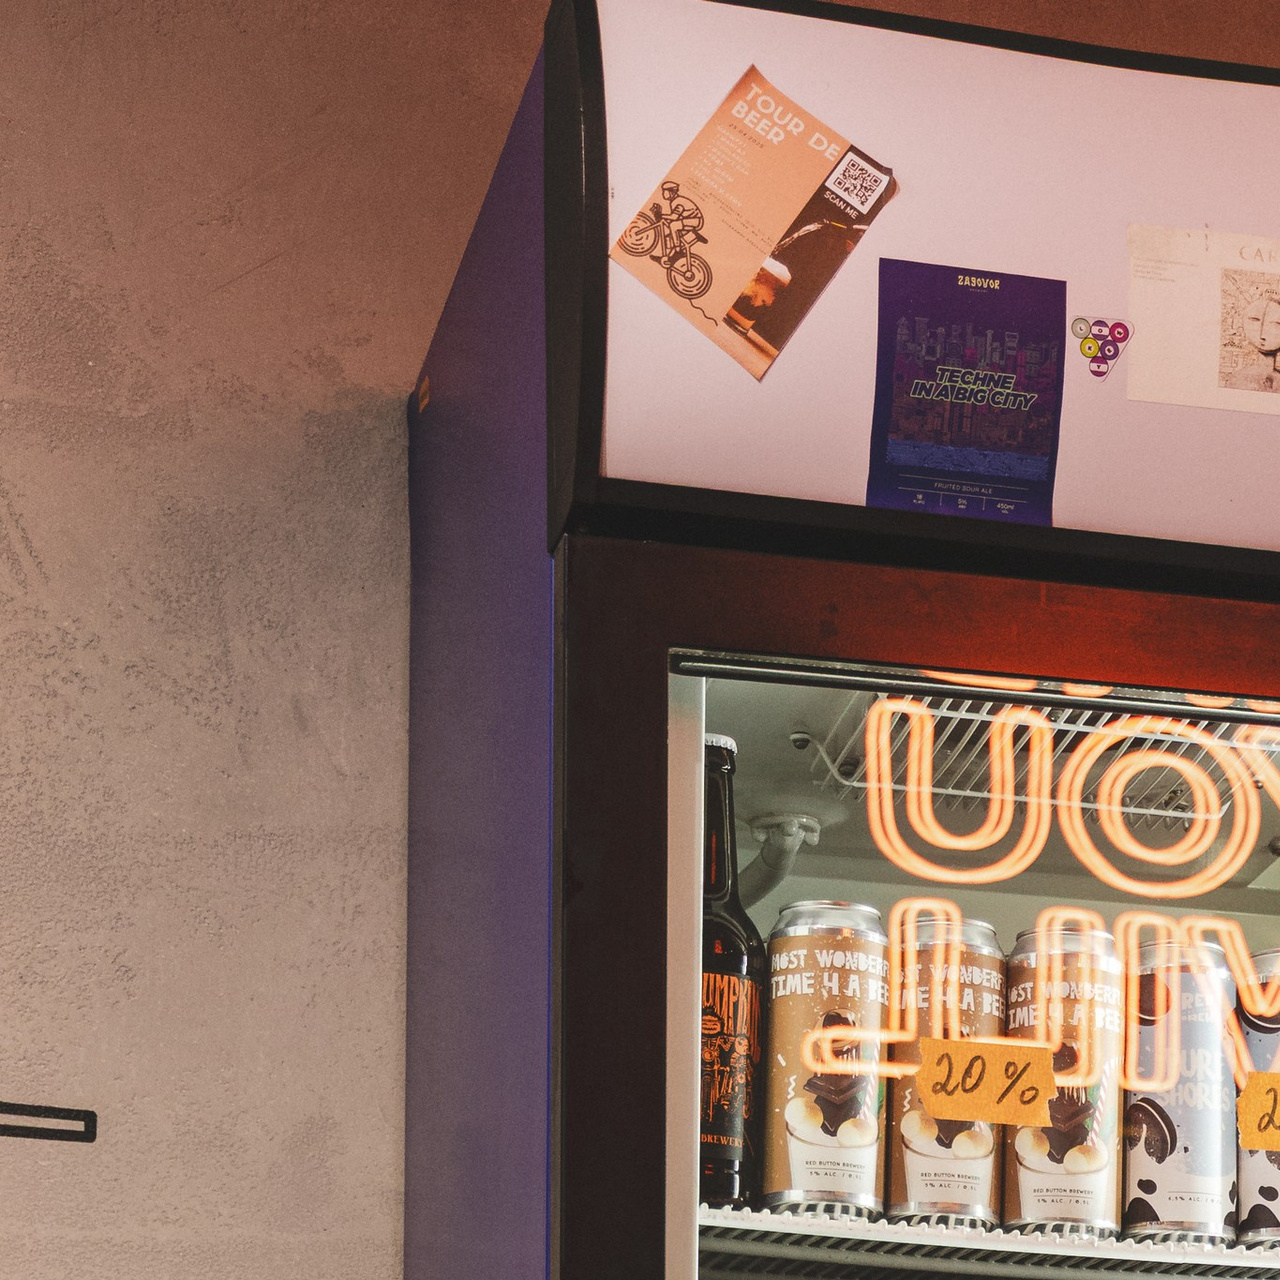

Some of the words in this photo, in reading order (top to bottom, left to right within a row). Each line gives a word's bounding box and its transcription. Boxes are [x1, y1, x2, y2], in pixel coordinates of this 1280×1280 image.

[731, 100, 785, 145] BEER
[745, 83, 805, 136] TOUR
[808, 132, 842, 162] DE
[823, 190, 846, 210] SCAN
[844, 205, 859, 219] ME
[935, 365, 1016, 393] TECHNE
[910, 379, 934, 399] IN
[933, 382, 952, 402] A
[950, 384, 989, 407] BIG
[989, 390, 1037, 411] CITY
[771, 950, 807, 972] MOST
[771, 972, 815, 999] TIME
[823, 972, 840, 994] 4
[843, 974, 861, 998] A
[818, 1160, 841, 1168] BUTTON
